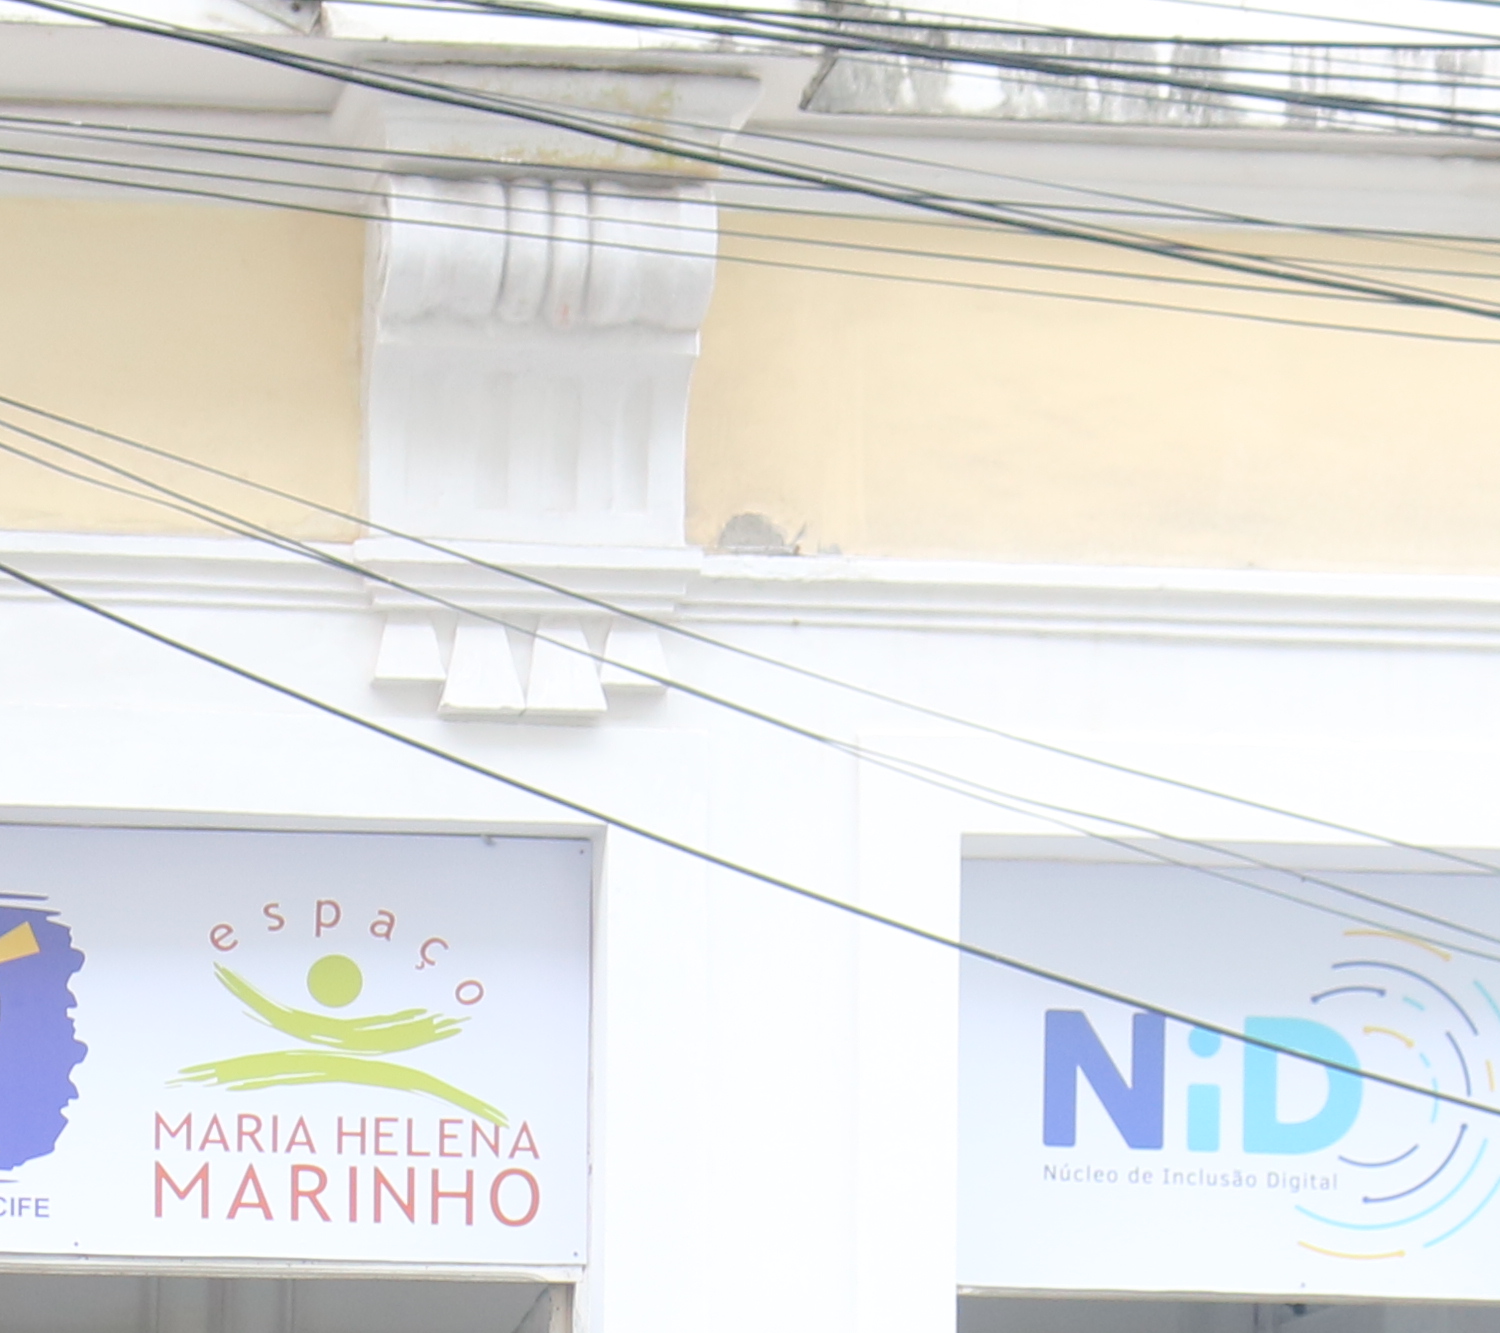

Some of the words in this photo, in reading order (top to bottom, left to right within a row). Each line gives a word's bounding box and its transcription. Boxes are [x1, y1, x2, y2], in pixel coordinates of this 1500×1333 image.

[209, 899, 484, 1006] espaço
[1042, 1009, 1363, 1155] NiD
[154, 1112, 317, 1154] MARIA
[337, 1116, 540, 1160] HELENA
[154, 1160, 540, 1228] MARINHO
[1043, 1163, 1119, 1184] Núcleo
[1127, 1167, 1154, 1186] de
[1162, 1167, 1258, 1189] Inclusão
[1267, 1171, 1339, 1194] Digital
